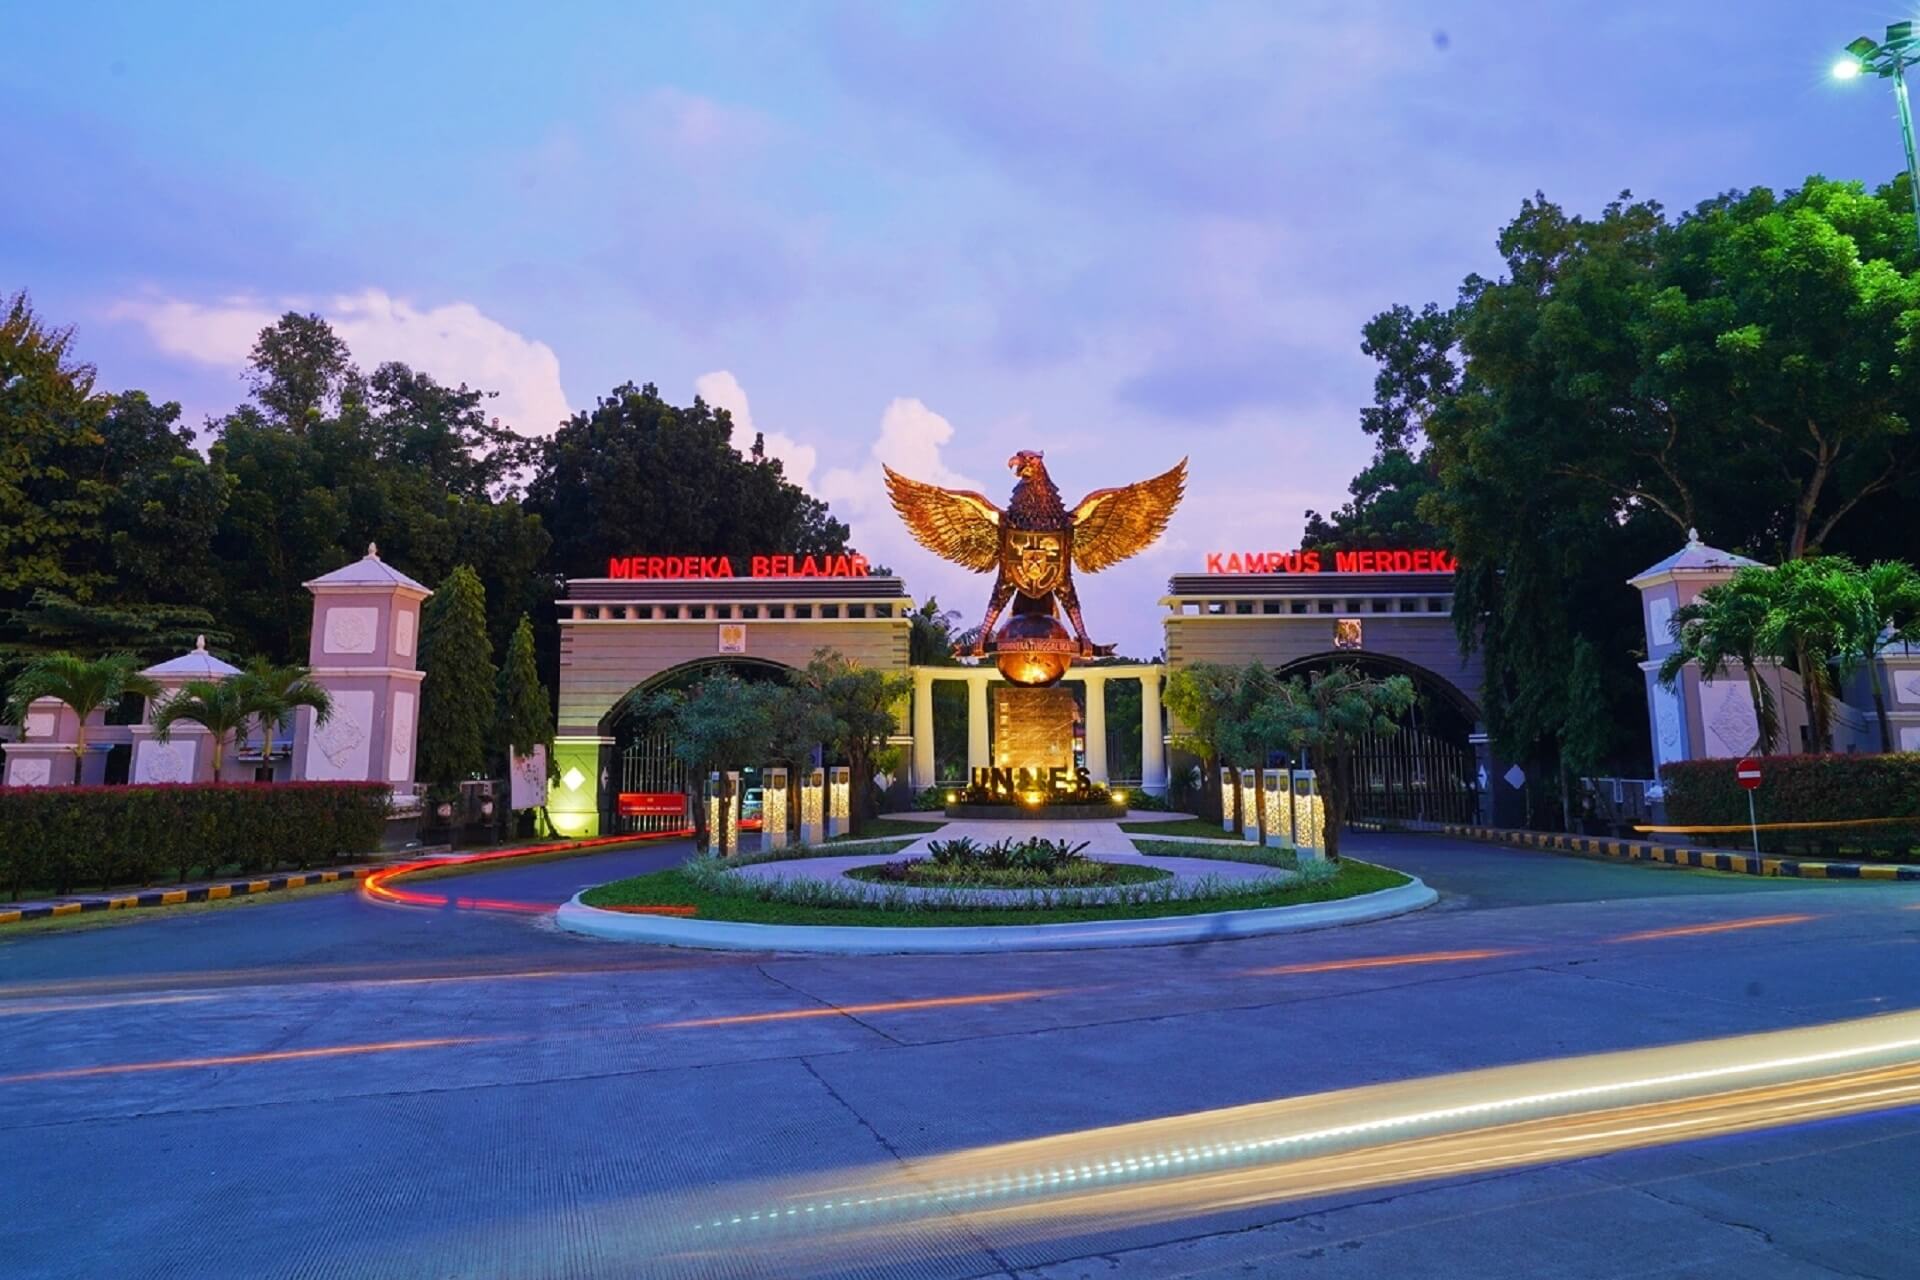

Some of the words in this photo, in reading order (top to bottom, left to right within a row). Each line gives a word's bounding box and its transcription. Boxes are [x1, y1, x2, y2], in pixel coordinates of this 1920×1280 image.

[609, 556, 734, 580] MERDEKA
[752, 555, 868, 578] BELAJAR
[1206, 552, 1320, 574] KAMPUS
